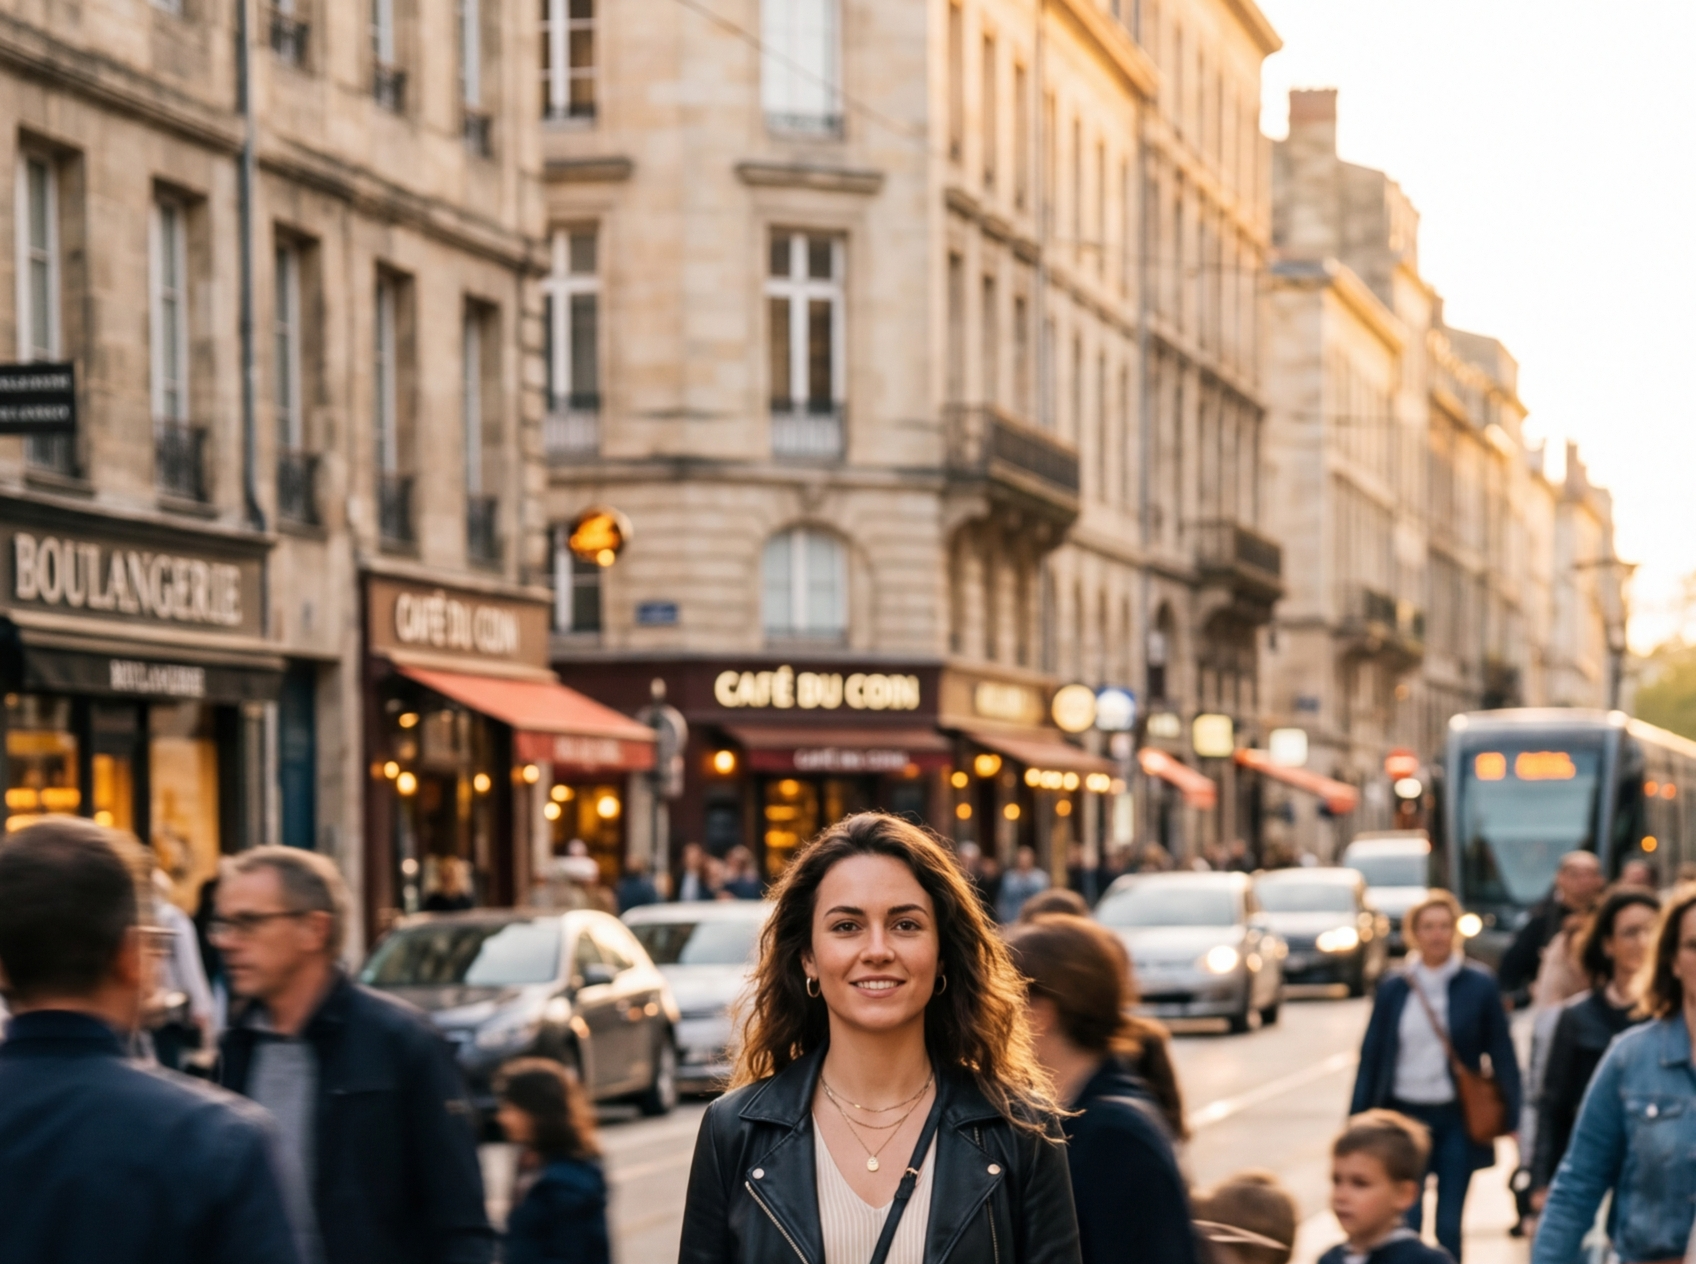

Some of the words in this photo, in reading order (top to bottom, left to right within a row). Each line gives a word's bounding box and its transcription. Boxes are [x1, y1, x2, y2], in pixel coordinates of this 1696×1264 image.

[14, 532, 242, 626] BOULANGERIE
[714, 665, 795, 708] CAFÉ
[796, 671, 843, 710] DU
[844, 672, 920, 711] COIN
